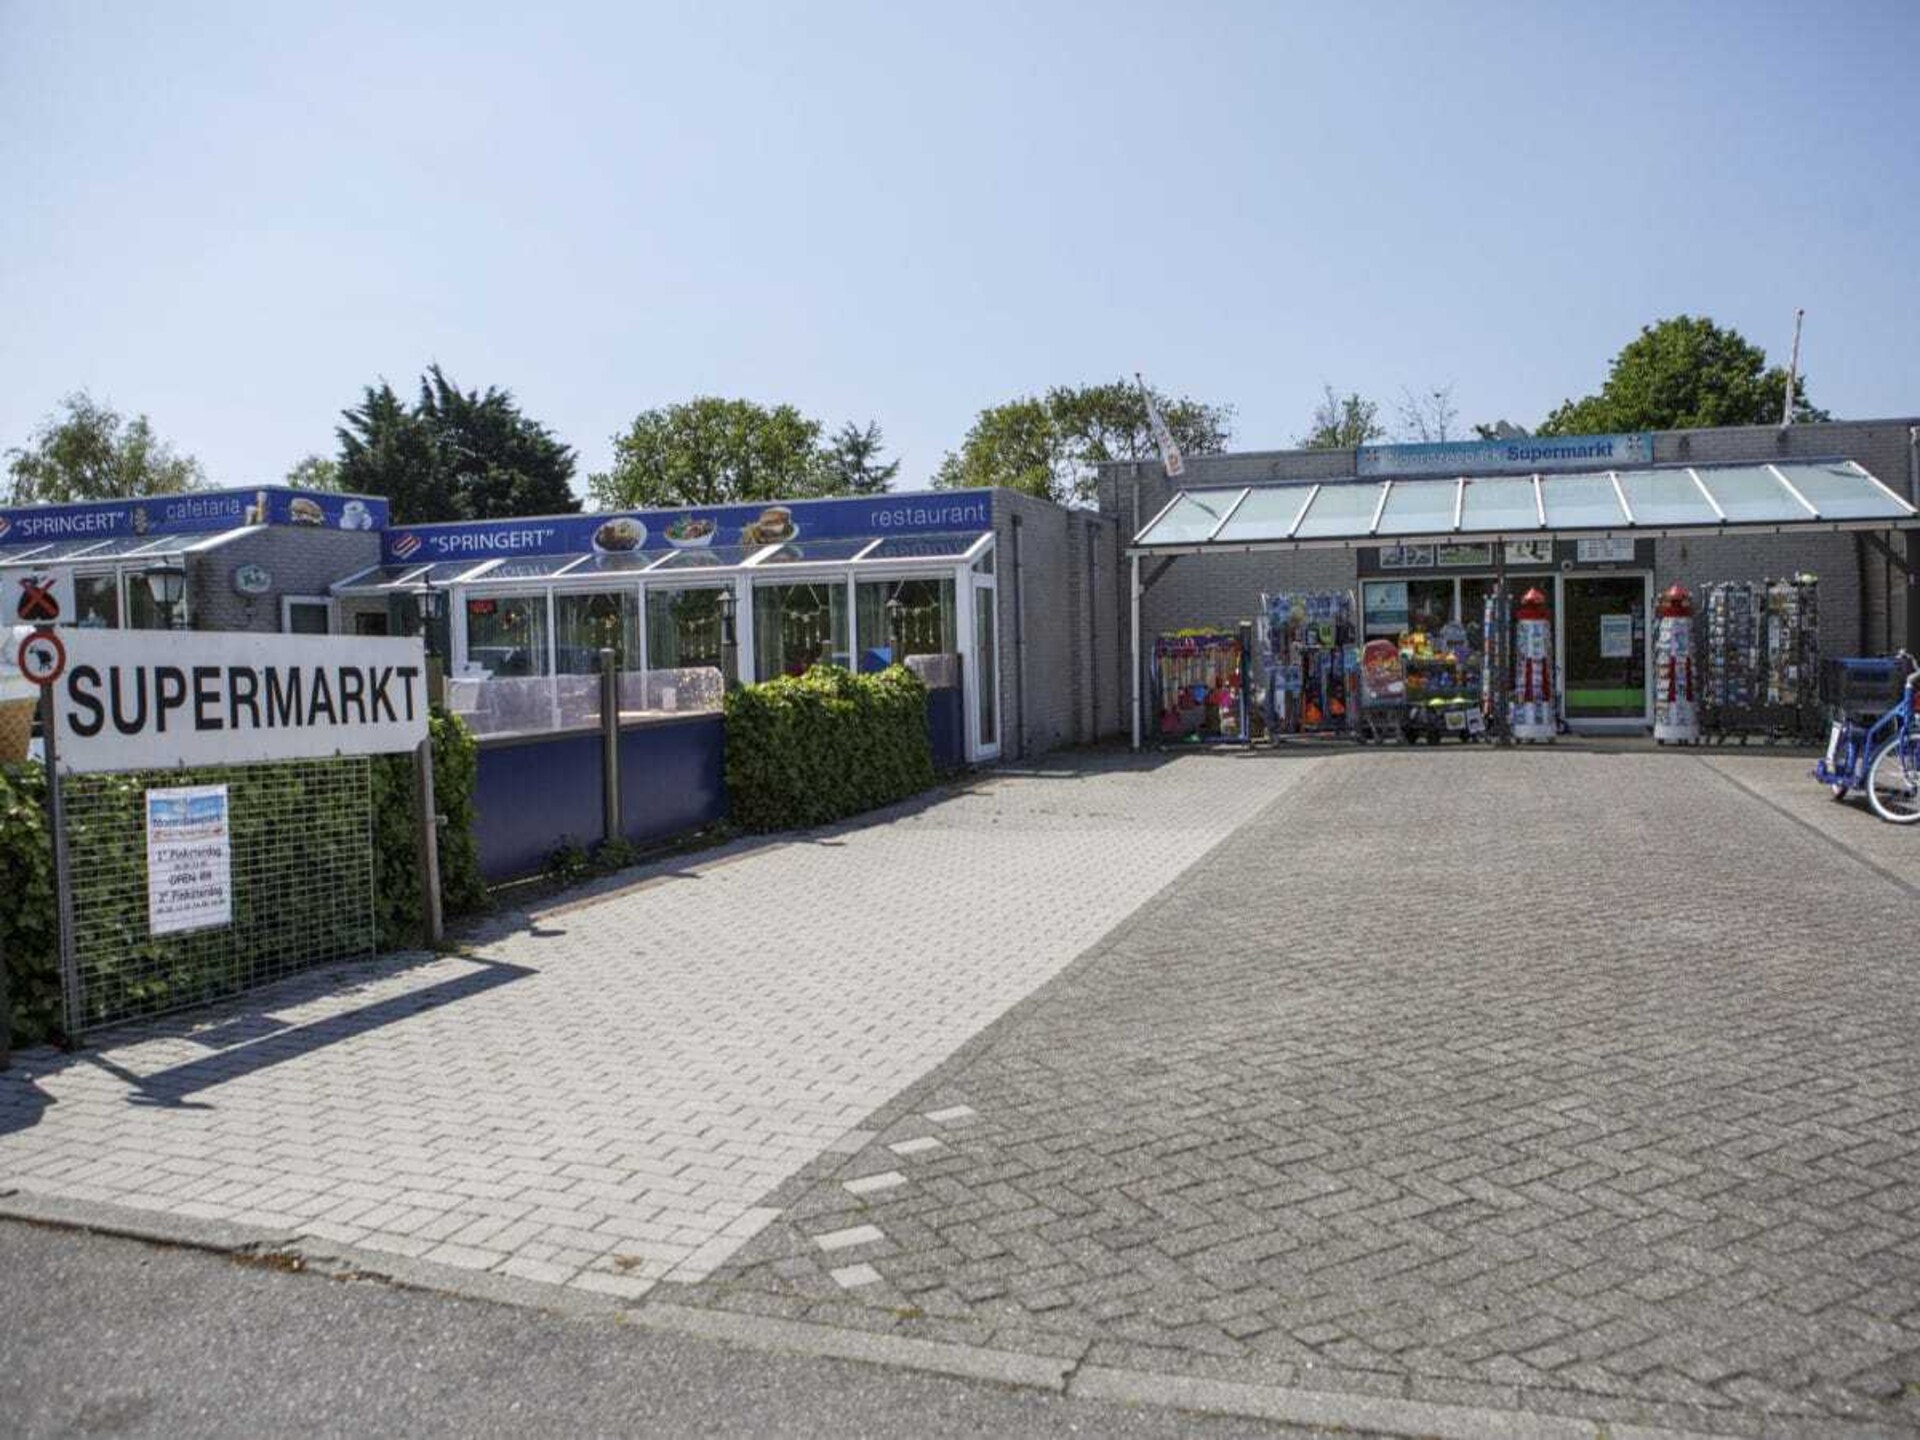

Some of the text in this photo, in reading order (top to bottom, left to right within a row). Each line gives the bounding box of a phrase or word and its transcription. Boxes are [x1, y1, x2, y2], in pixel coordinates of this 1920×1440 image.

[1507, 442, 1614, 463] Supermarkt
[166, 497, 240, 520] cafetaria
[871, 502, 986, 527] restaurant
[67, 664, 419, 737] SUPERMARKT
